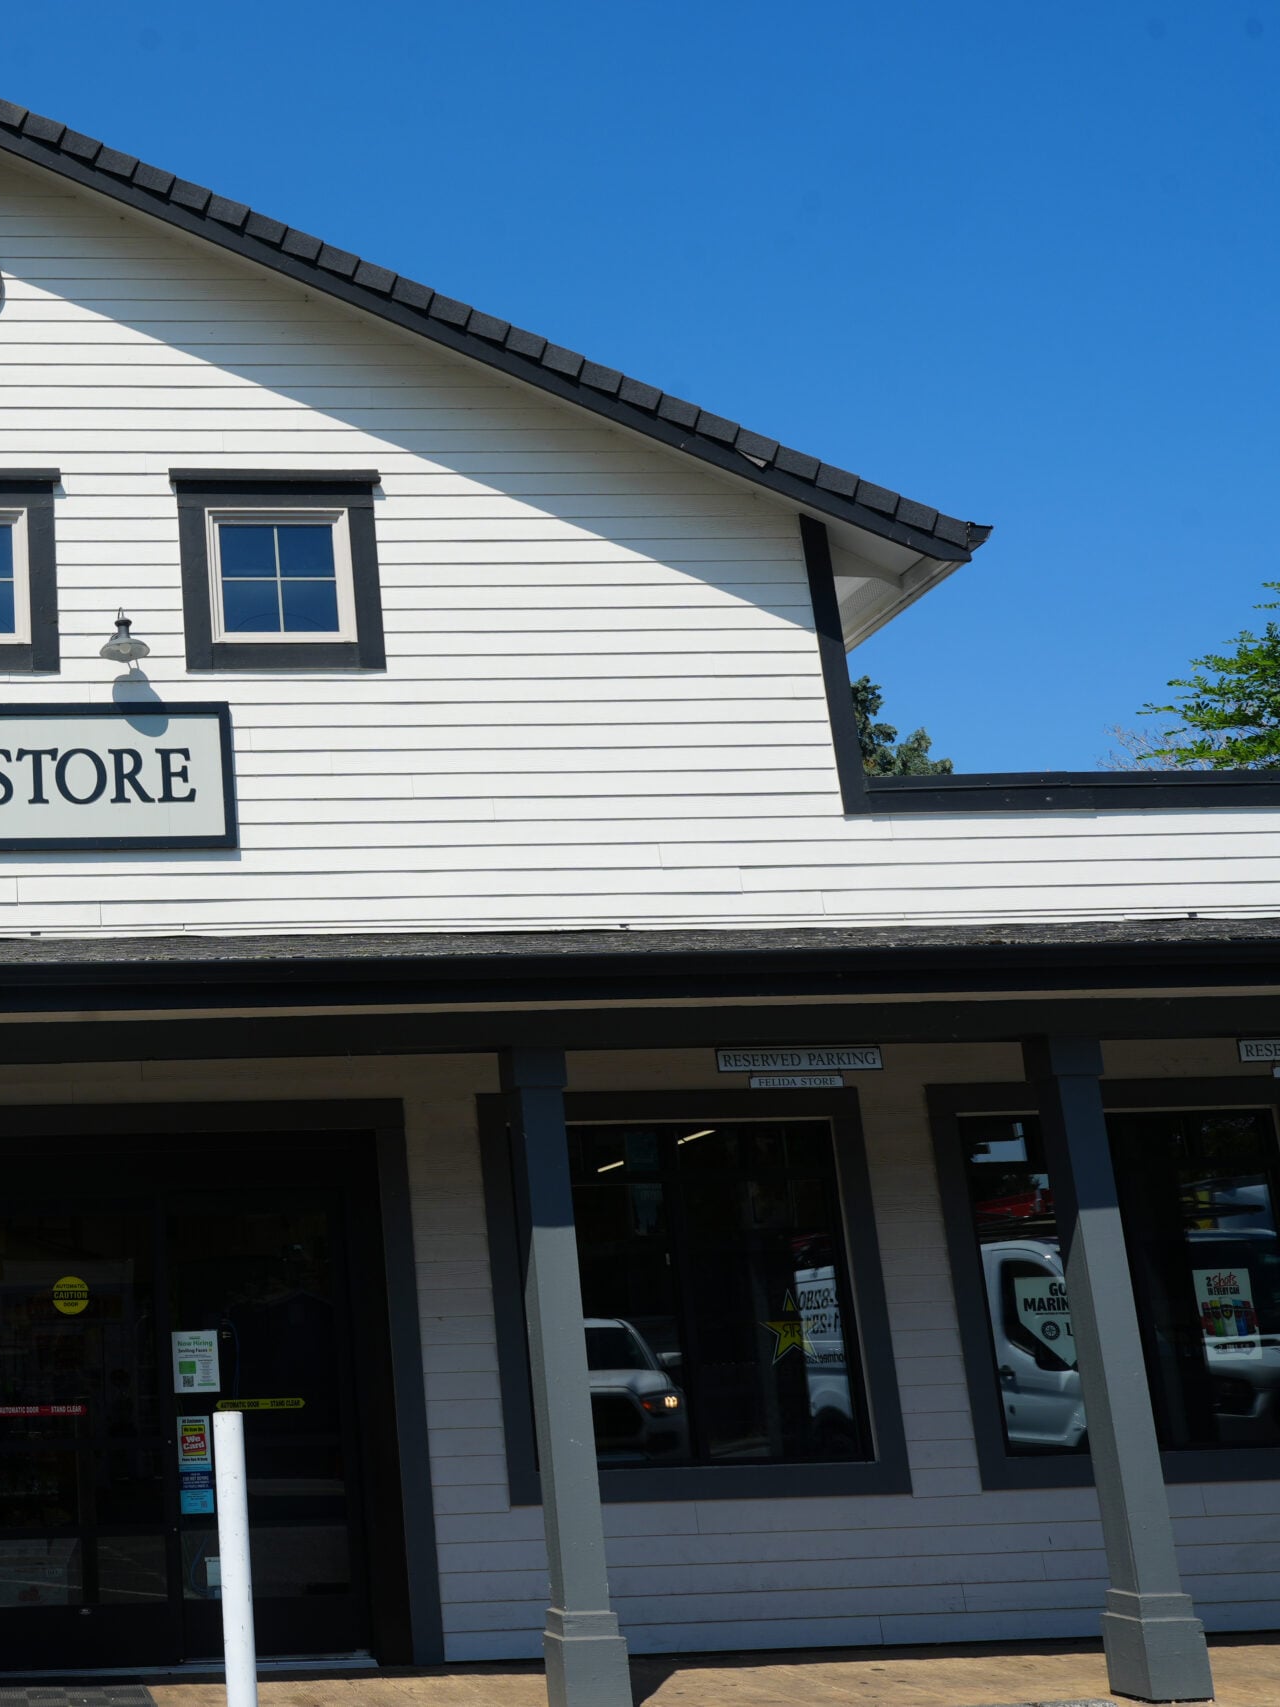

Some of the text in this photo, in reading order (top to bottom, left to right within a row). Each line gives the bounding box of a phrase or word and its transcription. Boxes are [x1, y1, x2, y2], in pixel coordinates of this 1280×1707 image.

[722, 1051, 877, 1068] RESERVED PARKING
[759, 1077, 836, 1087] FELIDA STORE
[53, 1291, 88, 1299] CAUTION
[193, 1340, 213, 1348] Hiring
[0, 1406, 26, 1415] AUTOMATIC
[26, 1406, 39, 1414] DOOR
[66, 1405, 82, 1413] CLEAR
[183, 1441, 205, 1450] Card
